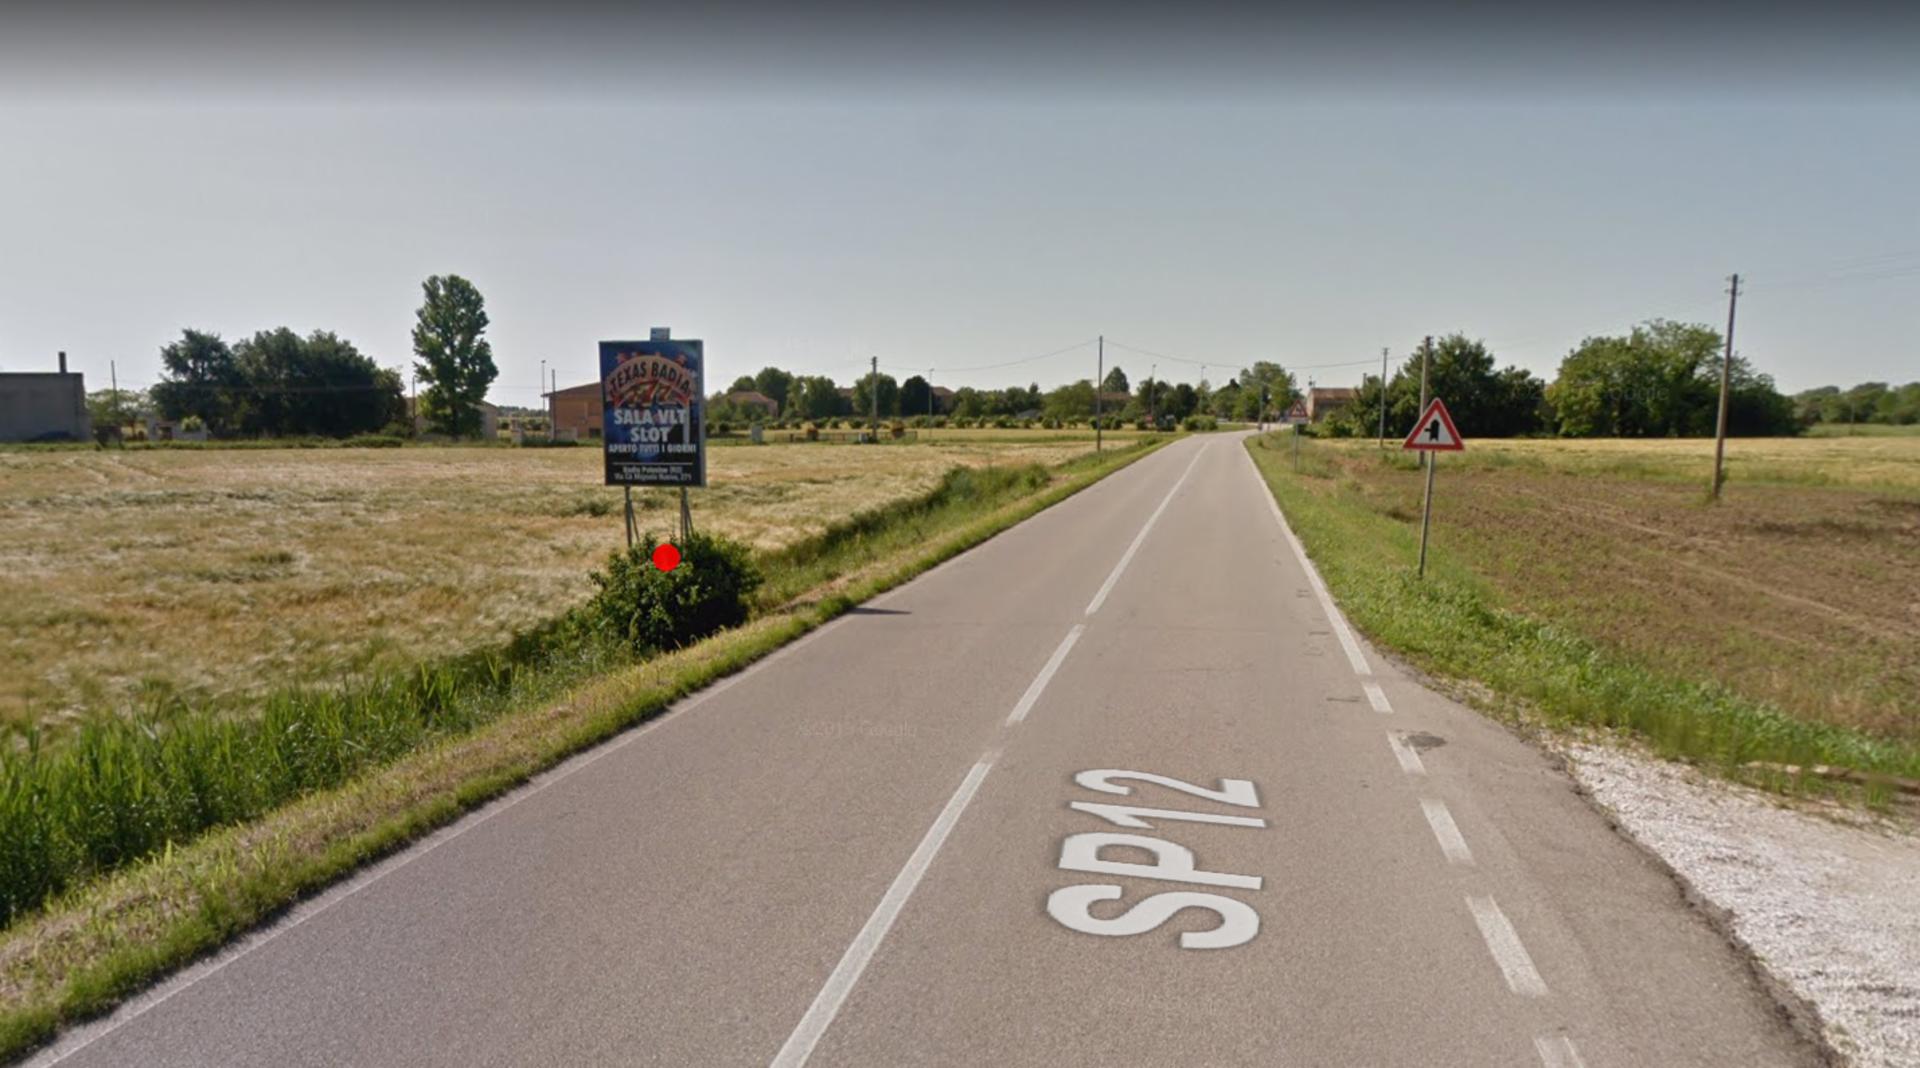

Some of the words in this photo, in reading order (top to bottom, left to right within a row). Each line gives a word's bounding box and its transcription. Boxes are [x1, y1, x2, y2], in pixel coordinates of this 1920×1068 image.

[610, 361, 647, 391] TEXAS
[652, 361, 690, 393] BADIA
[614, 408, 654, 425] SALA
[657, 408, 687, 425] VLT
[631, 426, 671, 443] SLOT
[608, 443, 637, 453] APERTO
[1047, 768, 1266, 949] SP12
